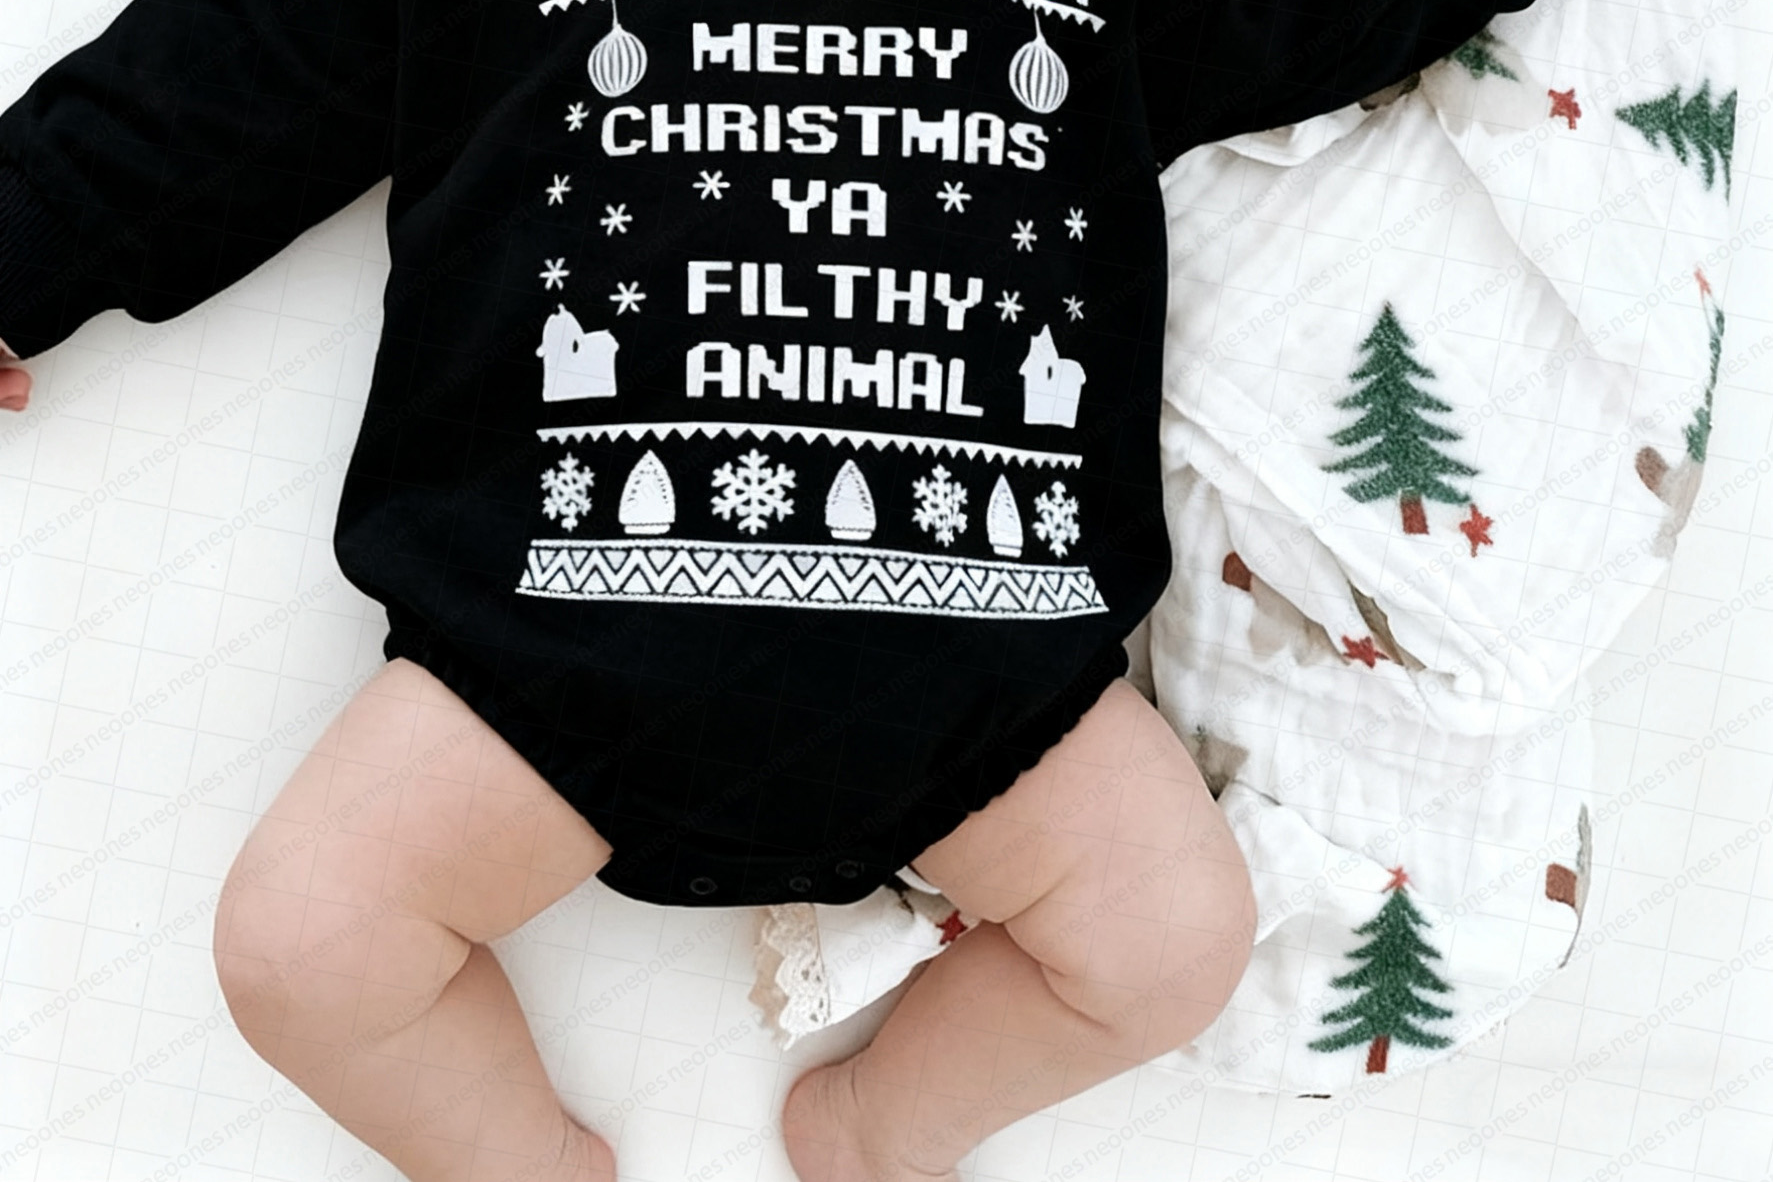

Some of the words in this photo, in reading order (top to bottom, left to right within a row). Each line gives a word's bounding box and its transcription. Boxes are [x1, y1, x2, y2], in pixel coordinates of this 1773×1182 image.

[693, 23, 967, 79] MERRY
[602, 104, 1049, 170] CHRISTMAS
[772, 179, 887, 236] YA
[688, 261, 983, 330] FILTHY
[686, 342, 983, 416] ANIMAL
